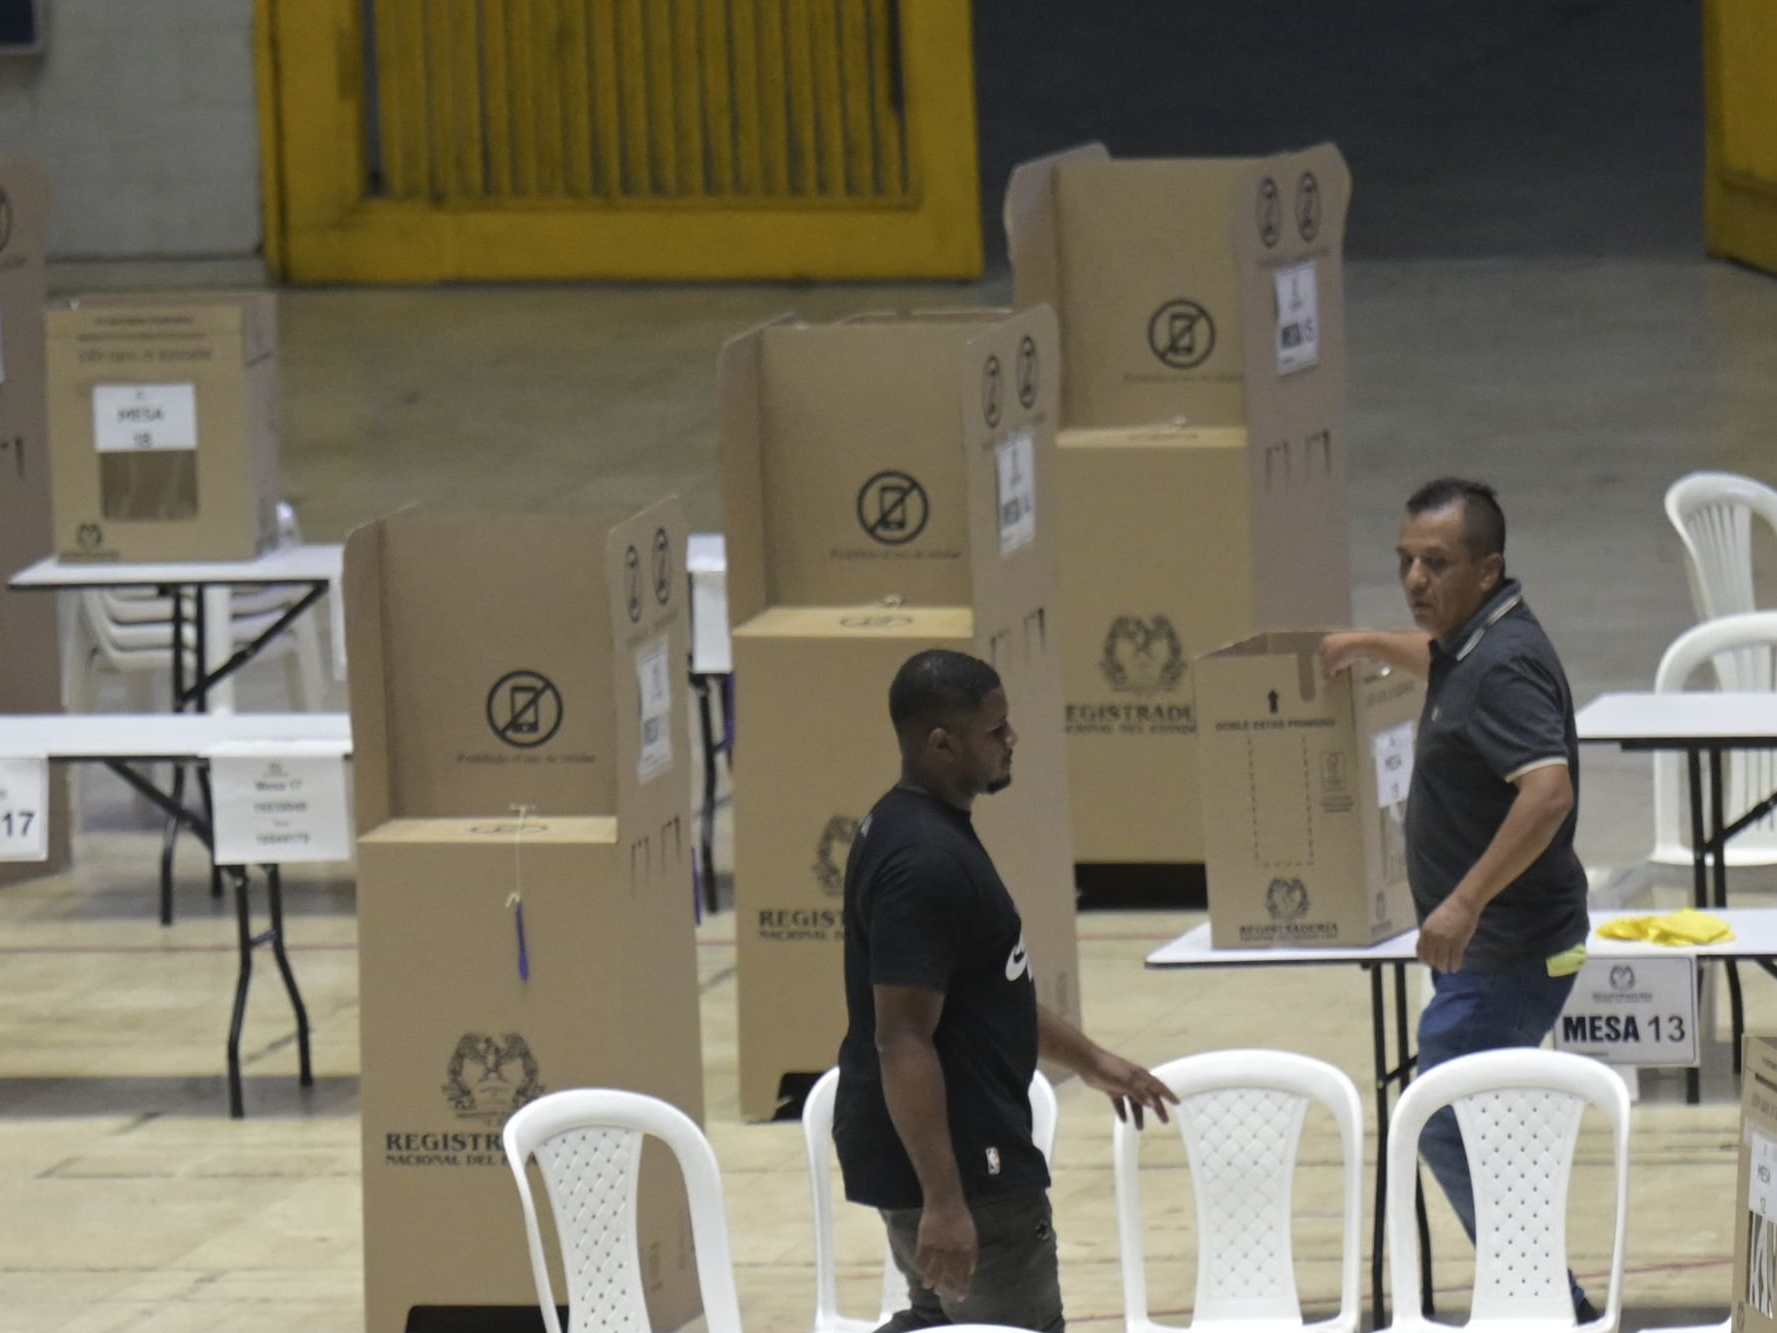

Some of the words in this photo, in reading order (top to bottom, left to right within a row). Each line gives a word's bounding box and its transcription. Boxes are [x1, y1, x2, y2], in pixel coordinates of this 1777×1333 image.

[2, 811, 36, 838] 17
[1562, 1015, 1641, 1043] MESA
[1647, 1014, 1686, 1043] 13
